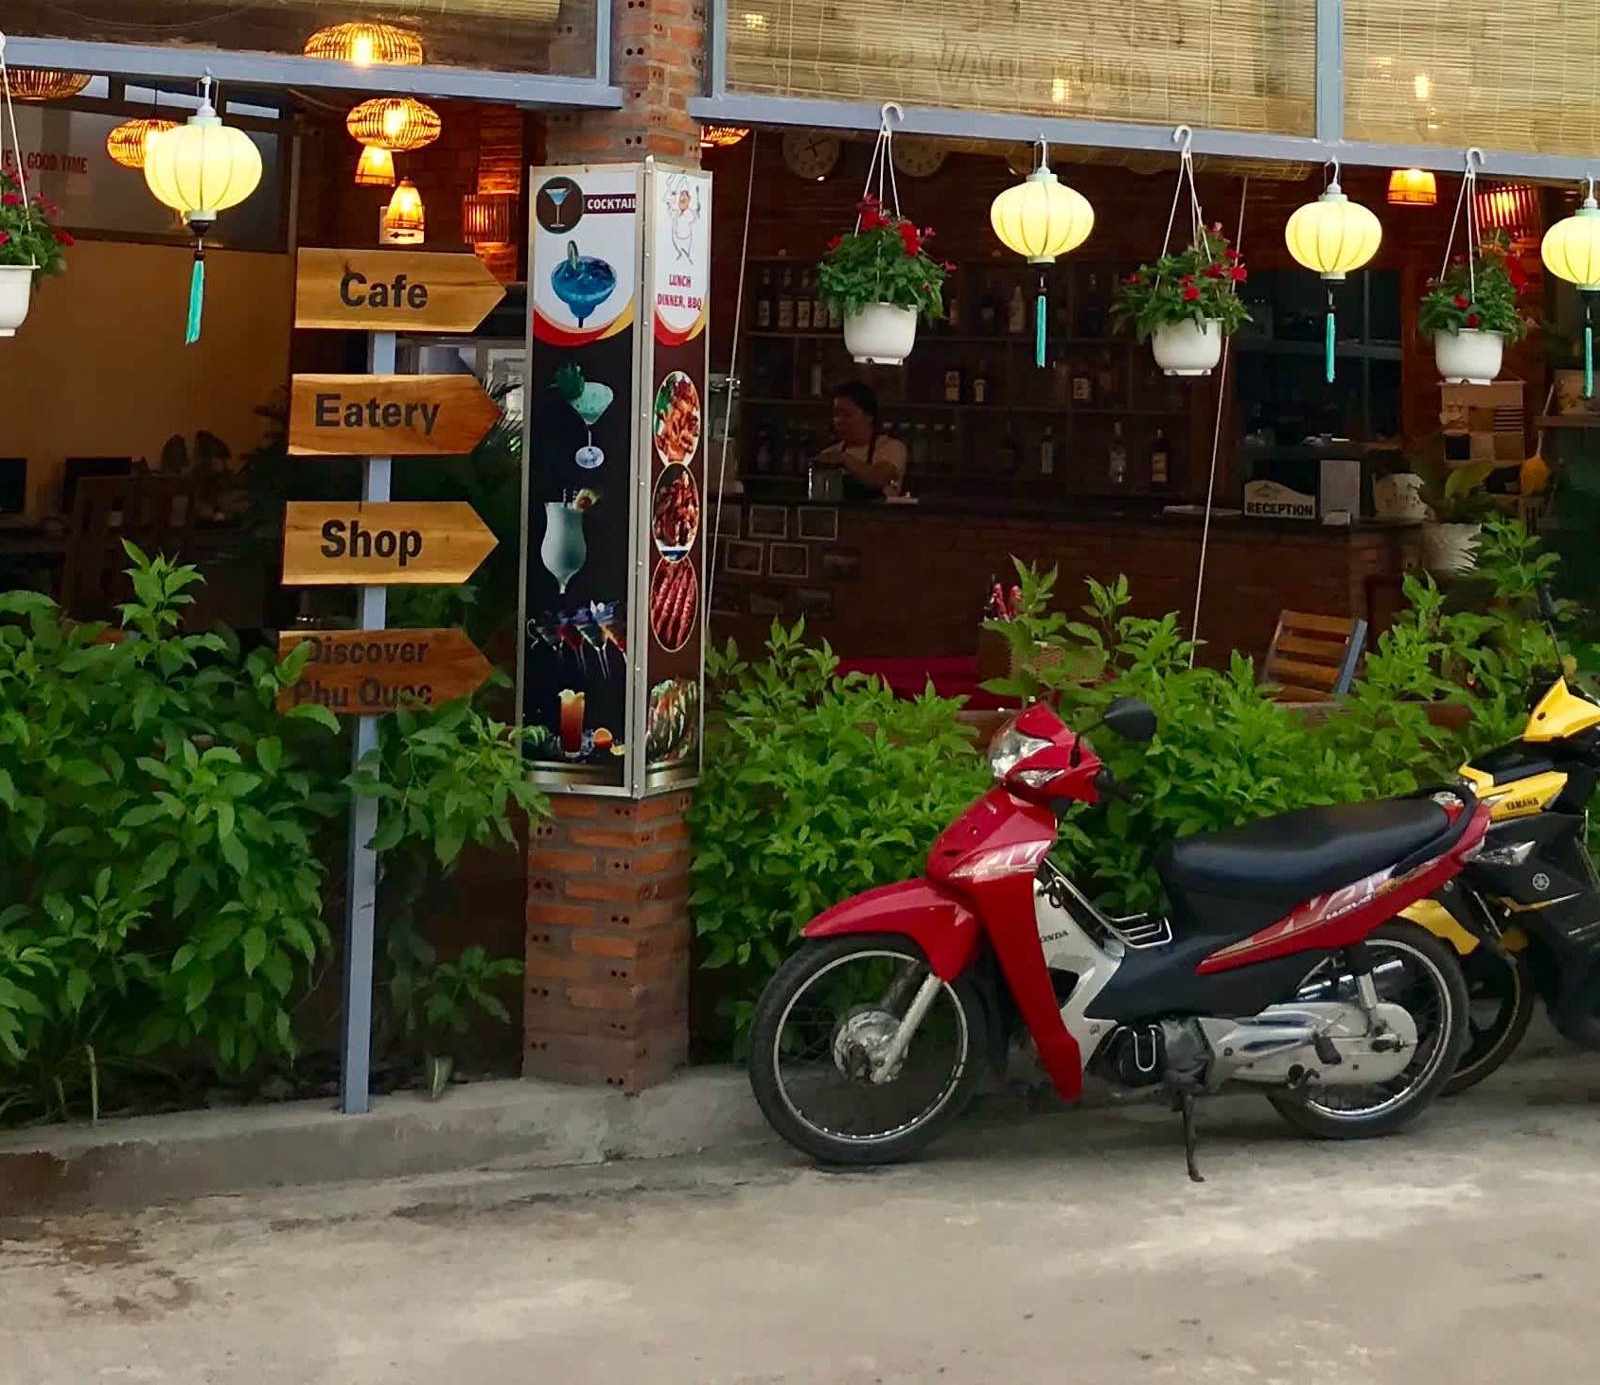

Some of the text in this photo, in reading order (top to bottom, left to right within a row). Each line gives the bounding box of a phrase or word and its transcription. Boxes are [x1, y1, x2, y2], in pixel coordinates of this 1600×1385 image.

[27, 152, 58, 170] GOOD
[60, 155, 88, 174] TIME
[340, 272, 428, 308] Cafe
[669, 274, 691, 288] LUNCH
[657, 293, 702, 311] DINNER, BBQ
[315, 393, 441, 435] Eatery
[1247, 502, 1313, 516] RECEPTION
[320, 519, 422, 567] Shop
[303, 635, 429, 663] Discover
[293, 678, 348, 708] Phu
[1505, 797, 1540, 811] YAMAHA
[1040, 930, 1069, 943] ONDA
